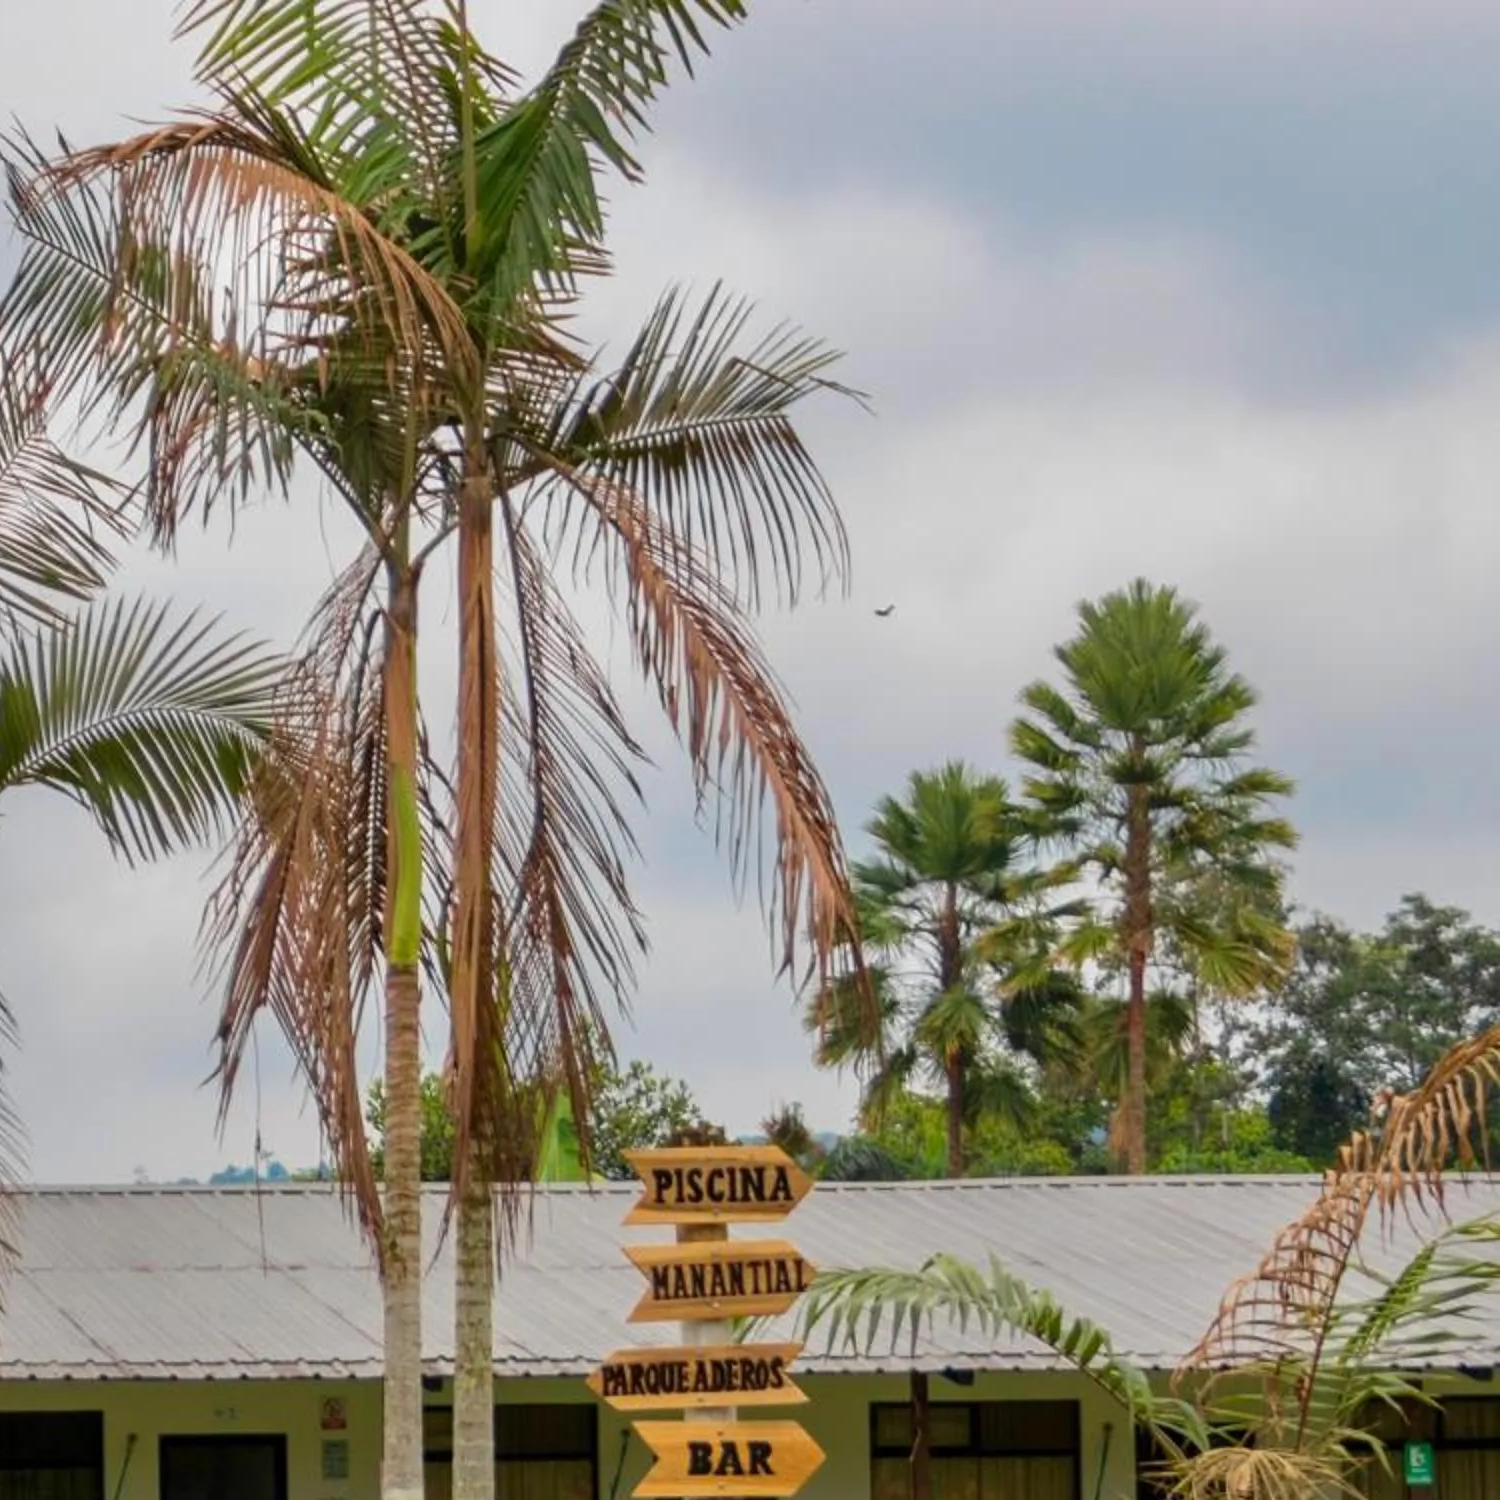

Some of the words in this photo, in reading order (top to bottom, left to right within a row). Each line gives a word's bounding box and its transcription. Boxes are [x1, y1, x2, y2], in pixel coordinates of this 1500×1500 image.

[653, 1167, 794, 1204] PISCINA
[651, 1258, 810, 1301] MANANTIAL
[602, 1356, 785, 1397] PARQUEADEROS
[687, 1440, 775, 1476] BAR
